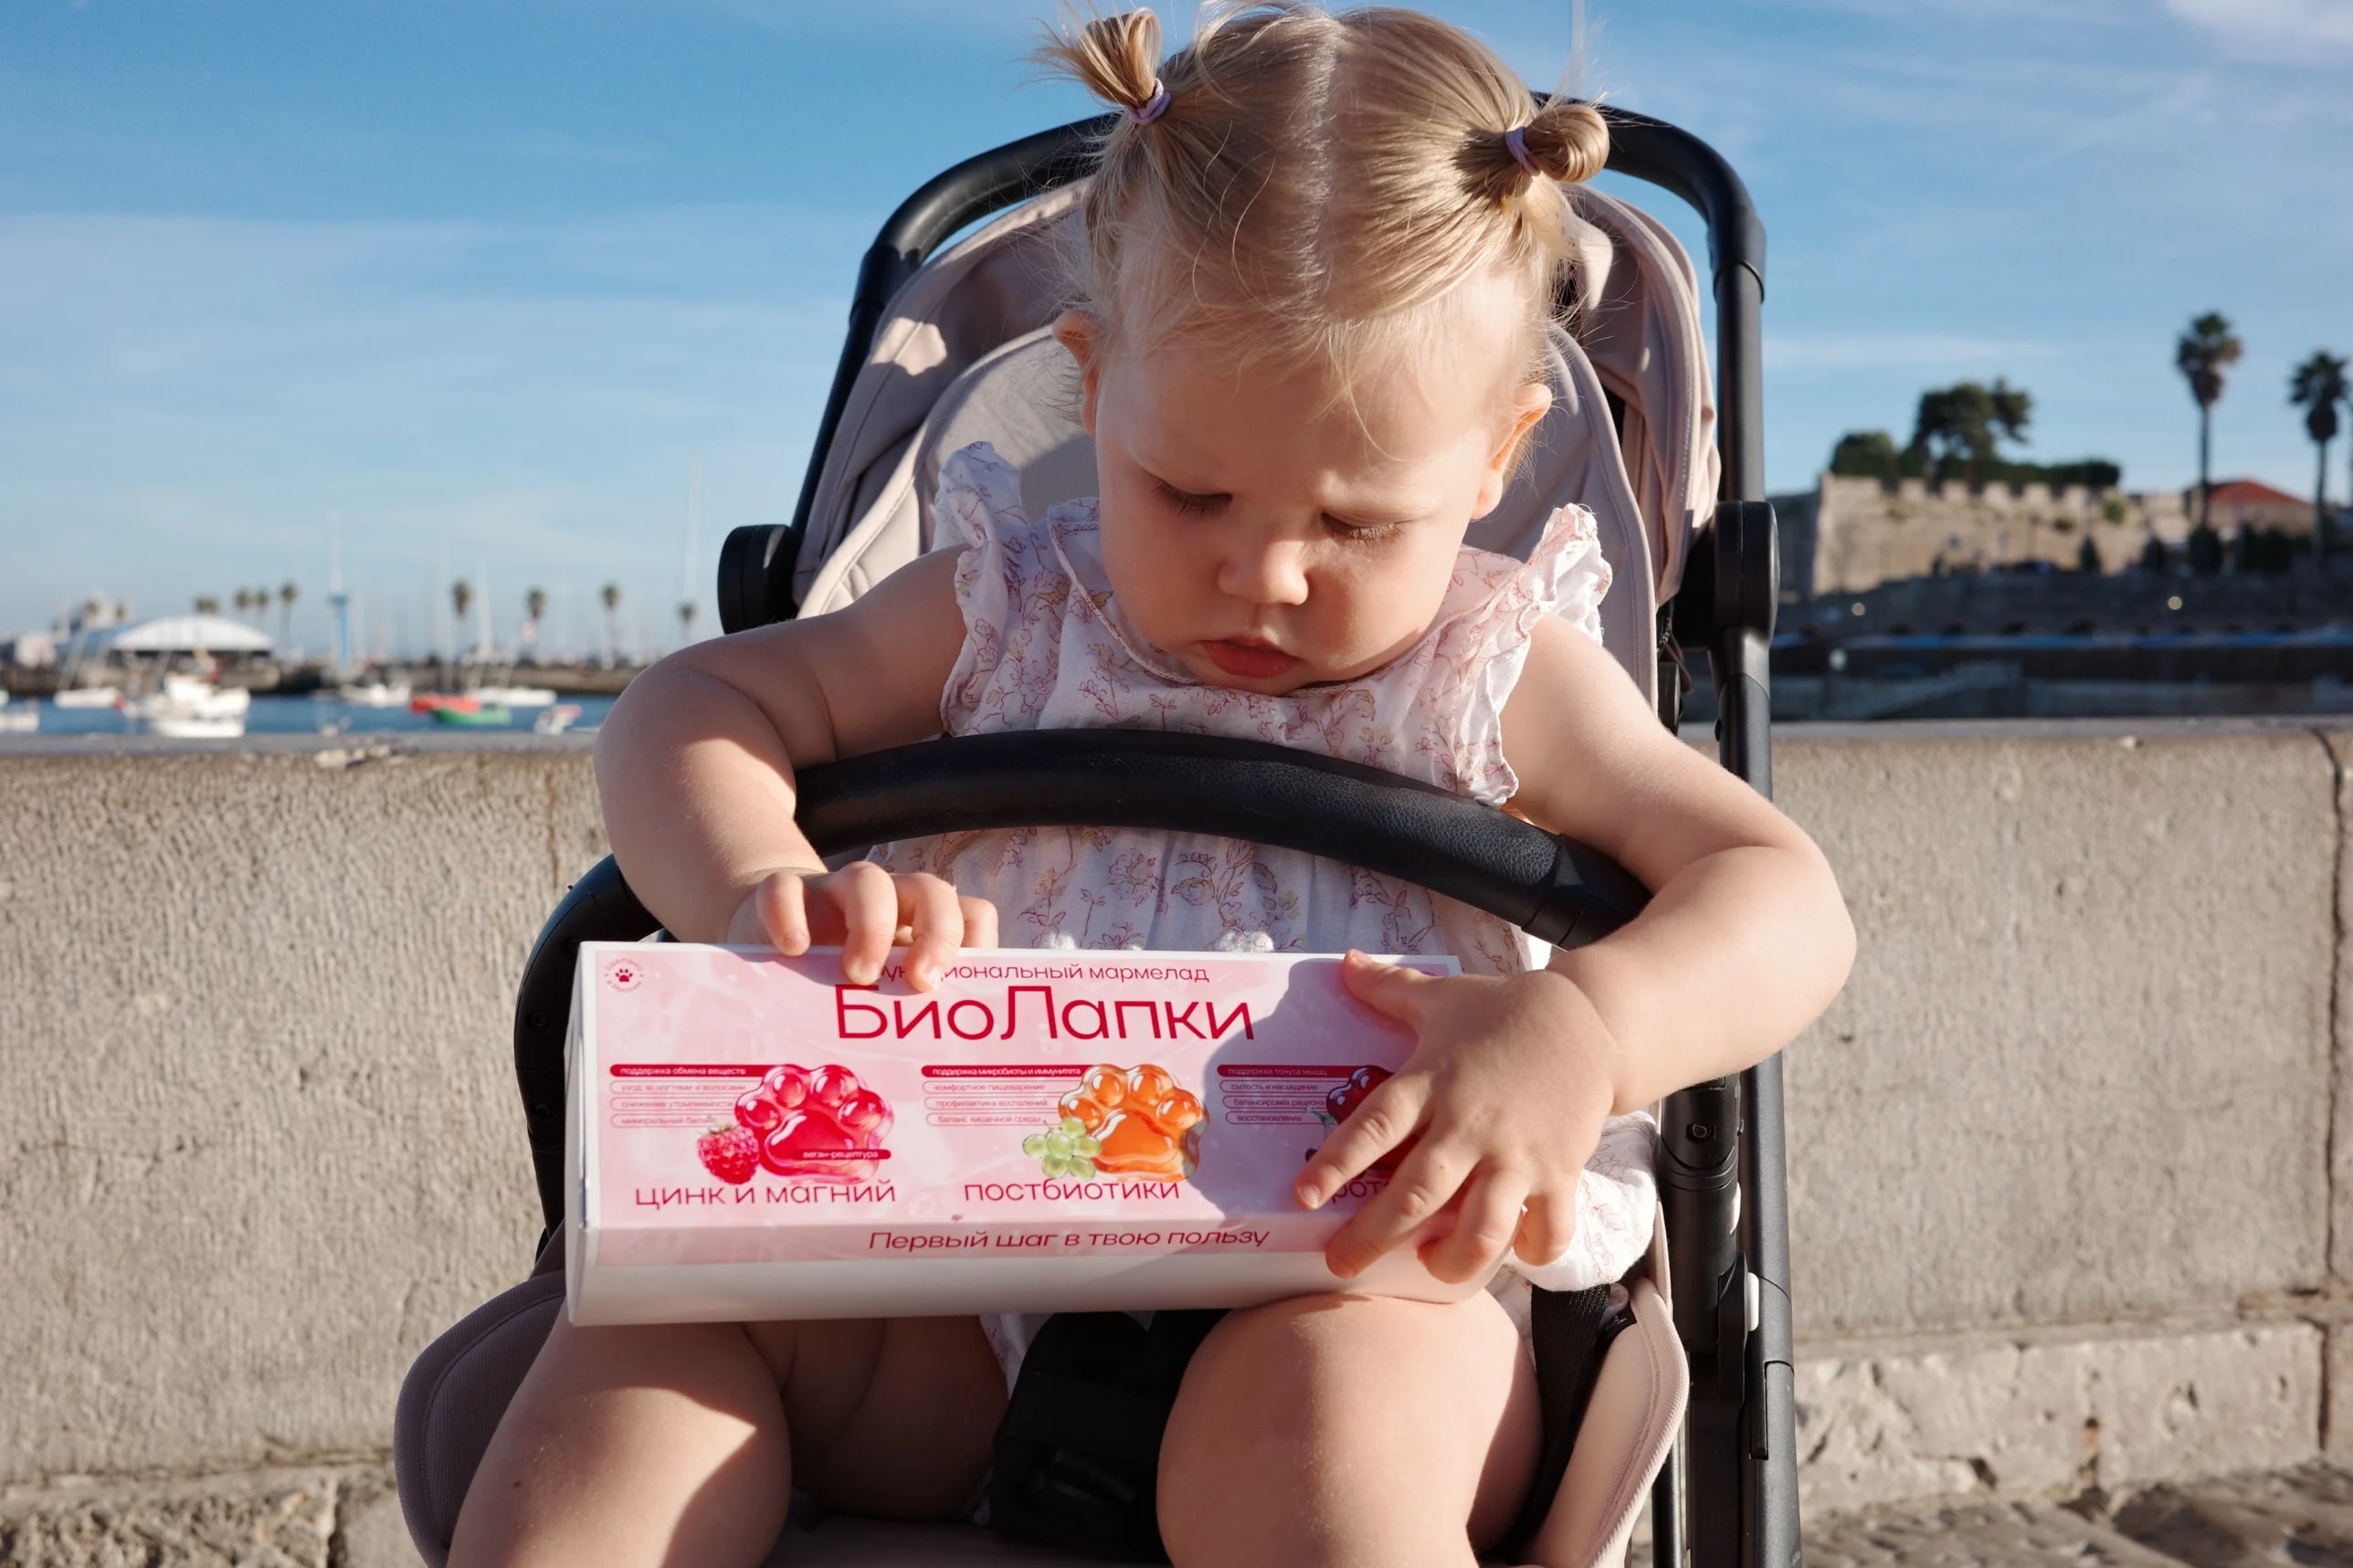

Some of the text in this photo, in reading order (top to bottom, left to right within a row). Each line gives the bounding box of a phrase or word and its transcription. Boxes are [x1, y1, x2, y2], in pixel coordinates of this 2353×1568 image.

[881, 963, 1209, 984] уиональный мармелад
[835, 984, 1254, 1040] БиоЛапки
[619, 1067, 746, 1077] поддержка обмена веществ
[932, 1068, 977, 1076] поддержка
[978, 1067, 1027, 1076] микробиоты
[1228, 1068, 1272, 1077] поддержка
[1275, 1068, 1302, 1077] тонуса
[1234, 1099, 1291, 1107] балансировка
[803, 1149, 879, 1159] веган-рецептура
[636, 1178, 895, 1211] цинк и магний
[964, 1178, 1179, 1202] постбиотики
[869, 1230, 1271, 1252] Первый шаг в твою пользу
